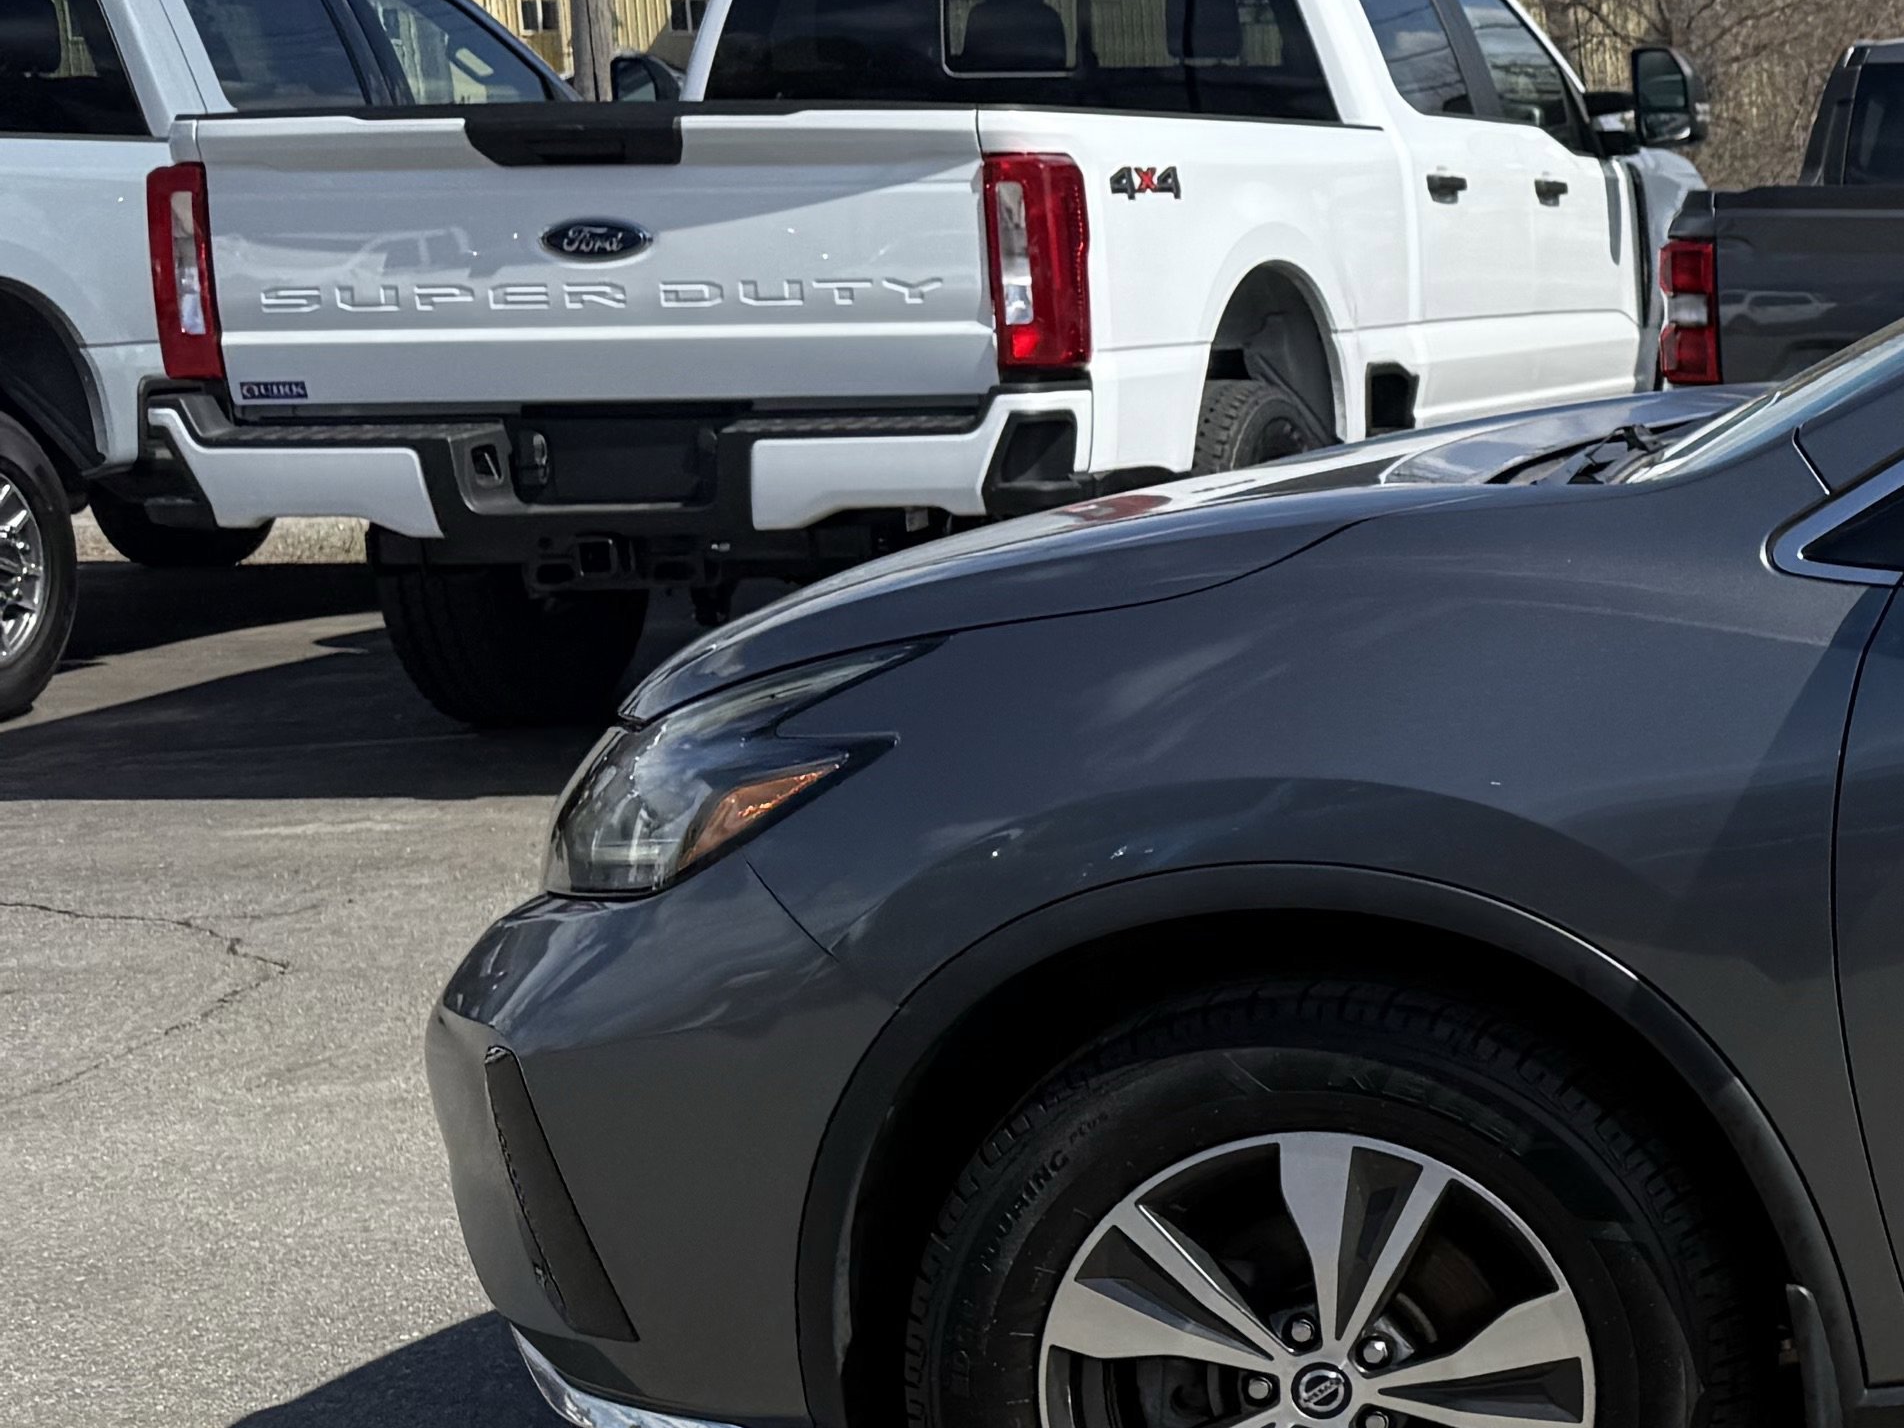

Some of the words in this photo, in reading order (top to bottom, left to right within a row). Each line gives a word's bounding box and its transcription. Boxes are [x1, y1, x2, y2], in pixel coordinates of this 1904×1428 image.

[563, 225, 623, 252] Ford
[260, 281, 628, 314] SUPER
[659, 278, 943, 308] DUTY
